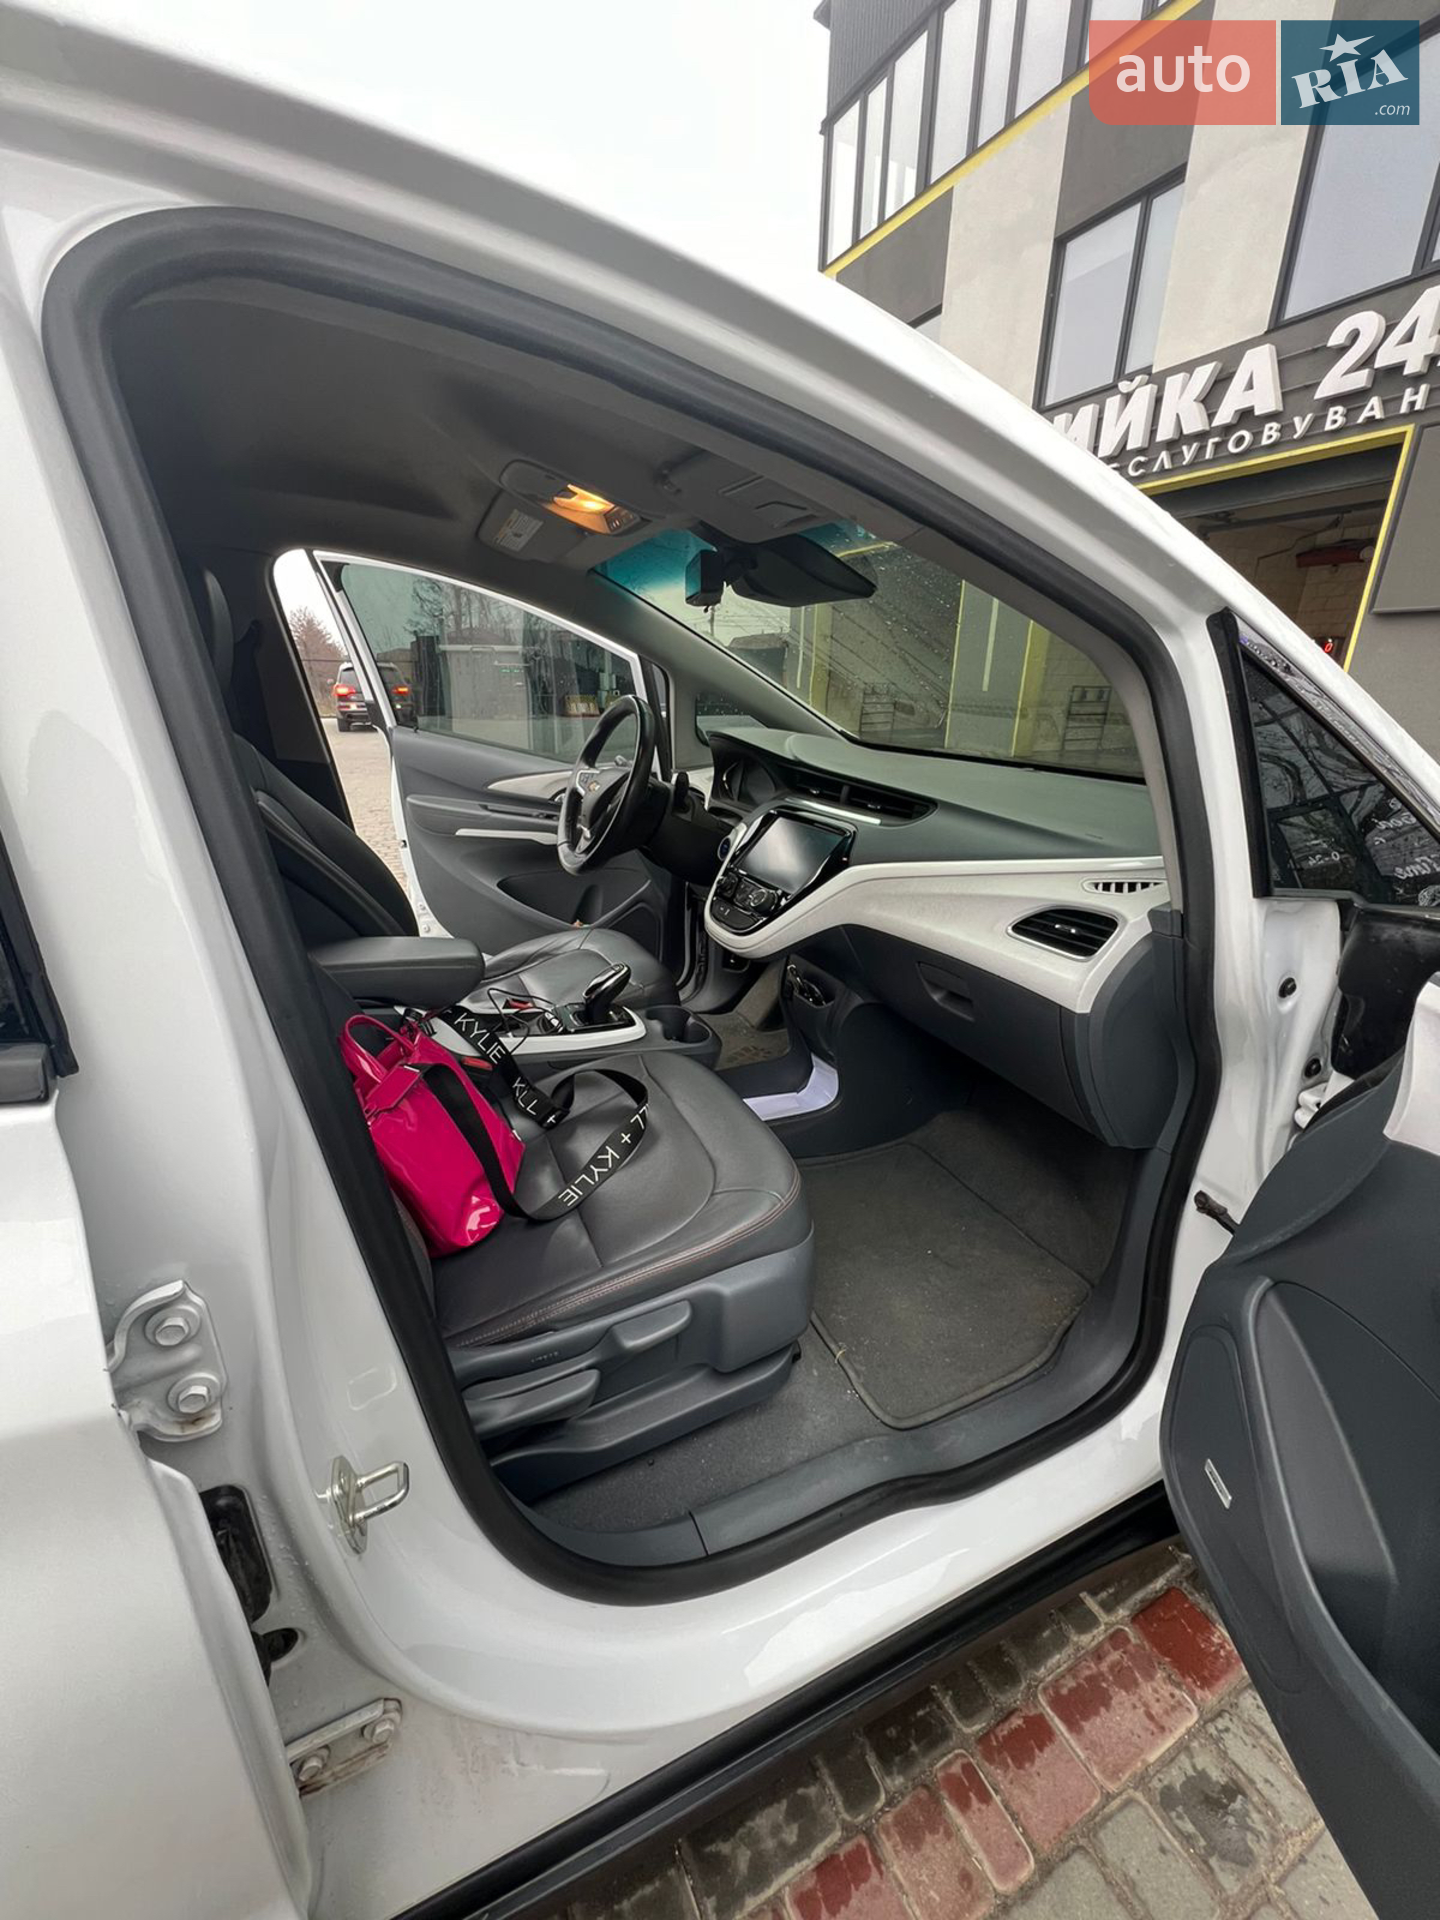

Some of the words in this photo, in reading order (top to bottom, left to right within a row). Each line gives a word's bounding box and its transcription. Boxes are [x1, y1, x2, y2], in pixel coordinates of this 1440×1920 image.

[1313, 285, 1440, 400] 24
[1107, 383, 1430, 477] СЛУГОВУВАН
[454, 1012, 506, 1065] KYLIE
[557, 1145, 620, 1207] KYLIE
